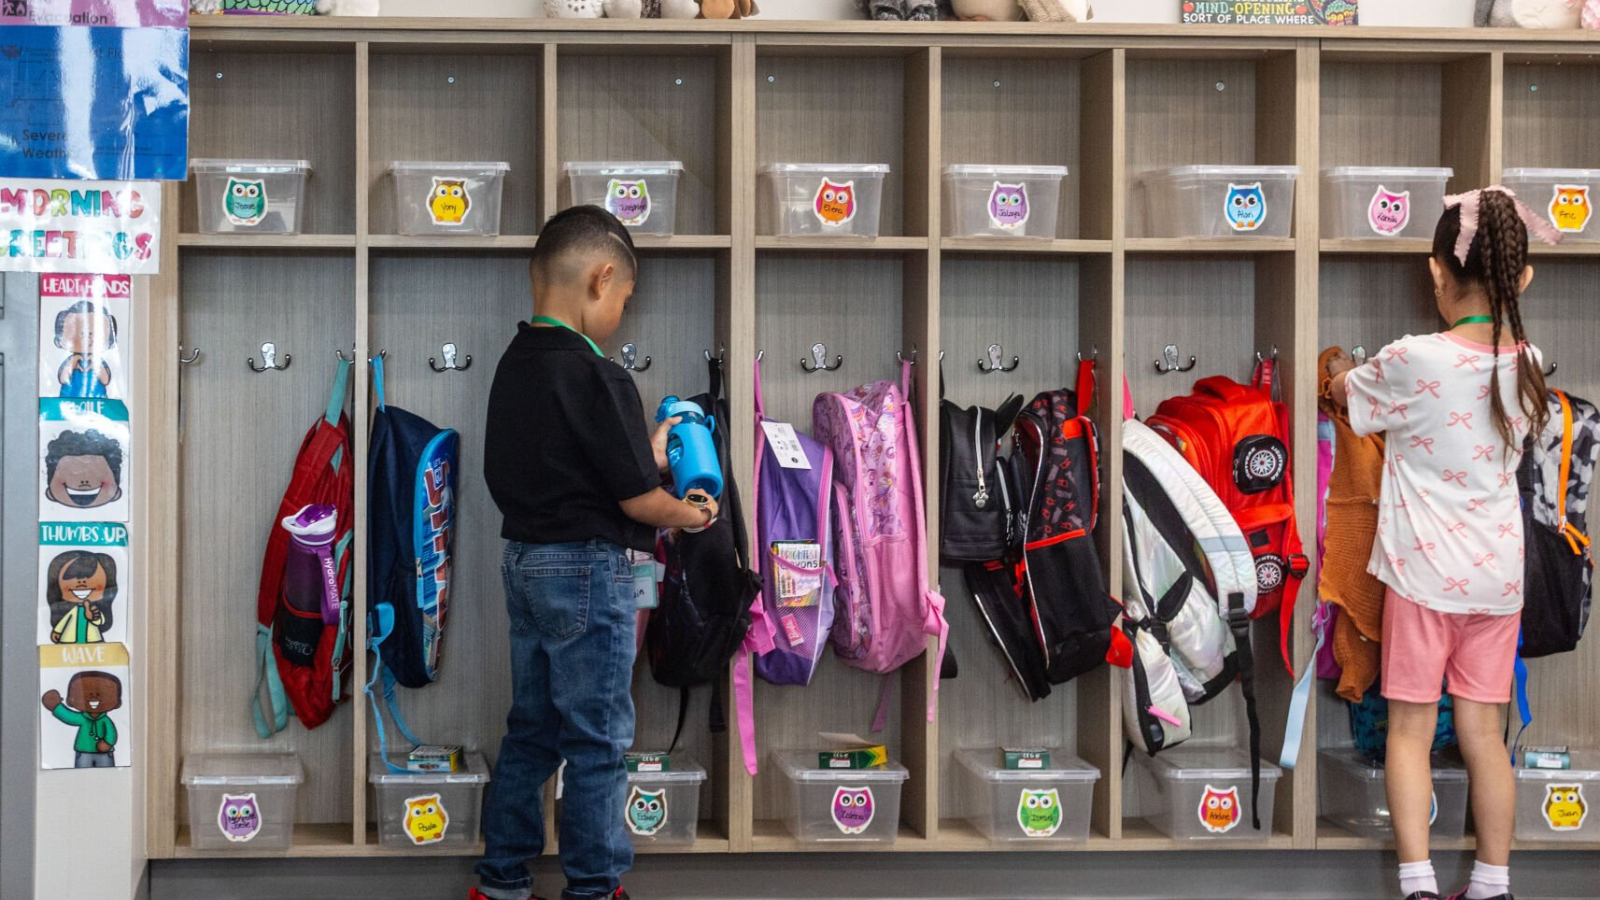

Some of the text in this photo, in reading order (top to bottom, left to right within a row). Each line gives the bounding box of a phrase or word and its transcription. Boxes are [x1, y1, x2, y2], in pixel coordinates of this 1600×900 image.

[1195, 2, 1295, 15] MIND-OPENING
[1183, 13, 1314, 25] SORT OF PLACE WHERE
[22, 147, 68, 159] Weath
[43, 278, 130, 294] HEART HNDS
[41, 525, 126, 543] THUMBS UP
[323, 557, 340, 610] HydroMATE
[61, 646, 105, 663] WAVE
